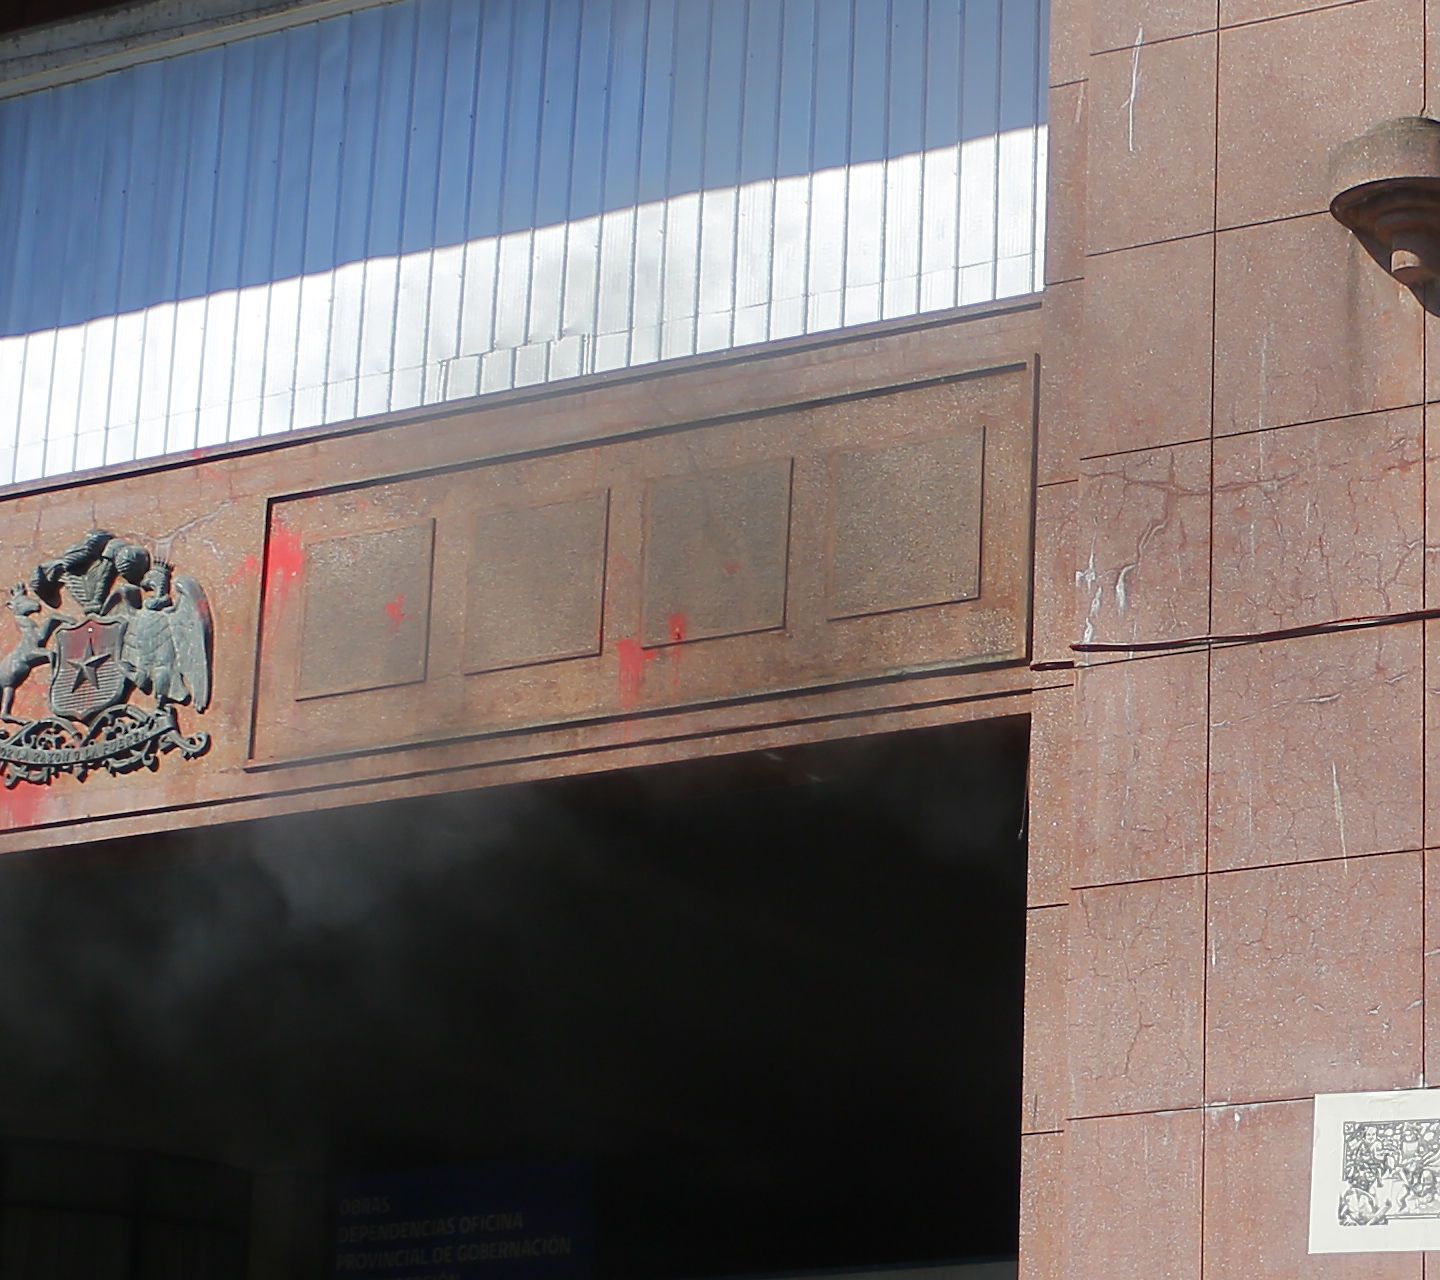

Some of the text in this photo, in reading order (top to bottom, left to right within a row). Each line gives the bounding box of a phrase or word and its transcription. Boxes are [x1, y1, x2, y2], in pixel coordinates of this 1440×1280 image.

[338, 1195, 392, 1217] OBRAS
[336, 1211, 524, 1243] DEPENDENCIAS OFICINA
[335, 1234, 573, 1272] PROVINCIAL DE GOBERNACIÓN
